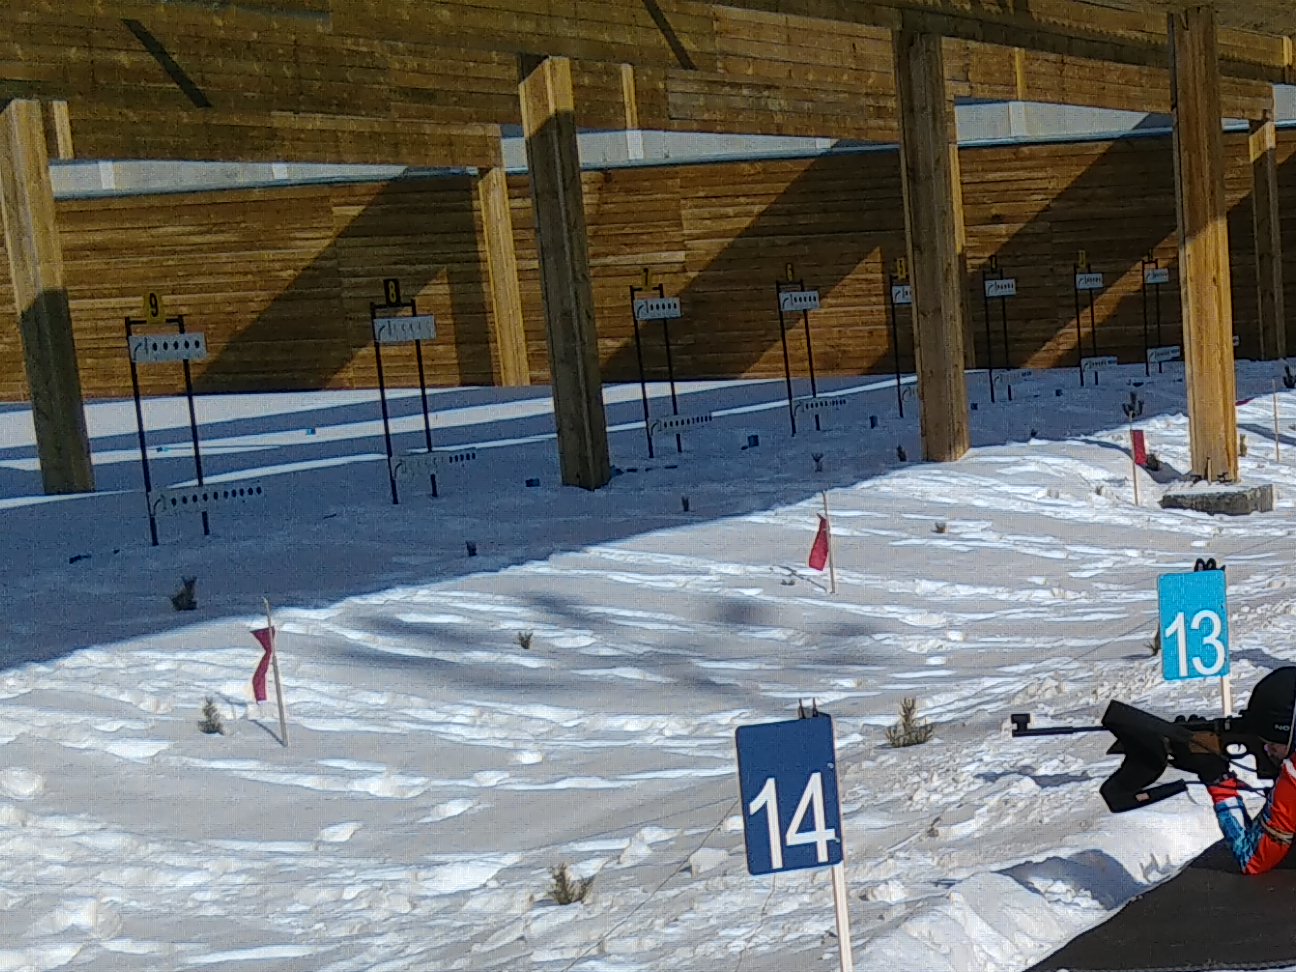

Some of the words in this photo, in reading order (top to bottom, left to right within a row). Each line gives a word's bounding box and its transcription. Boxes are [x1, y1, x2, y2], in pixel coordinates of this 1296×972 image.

[150, 292, 158, 317] 9
[388, 280, 397, 304] 8
[1165, 610, 1226, 677] 13
[749, 772, 837, 869] 14
